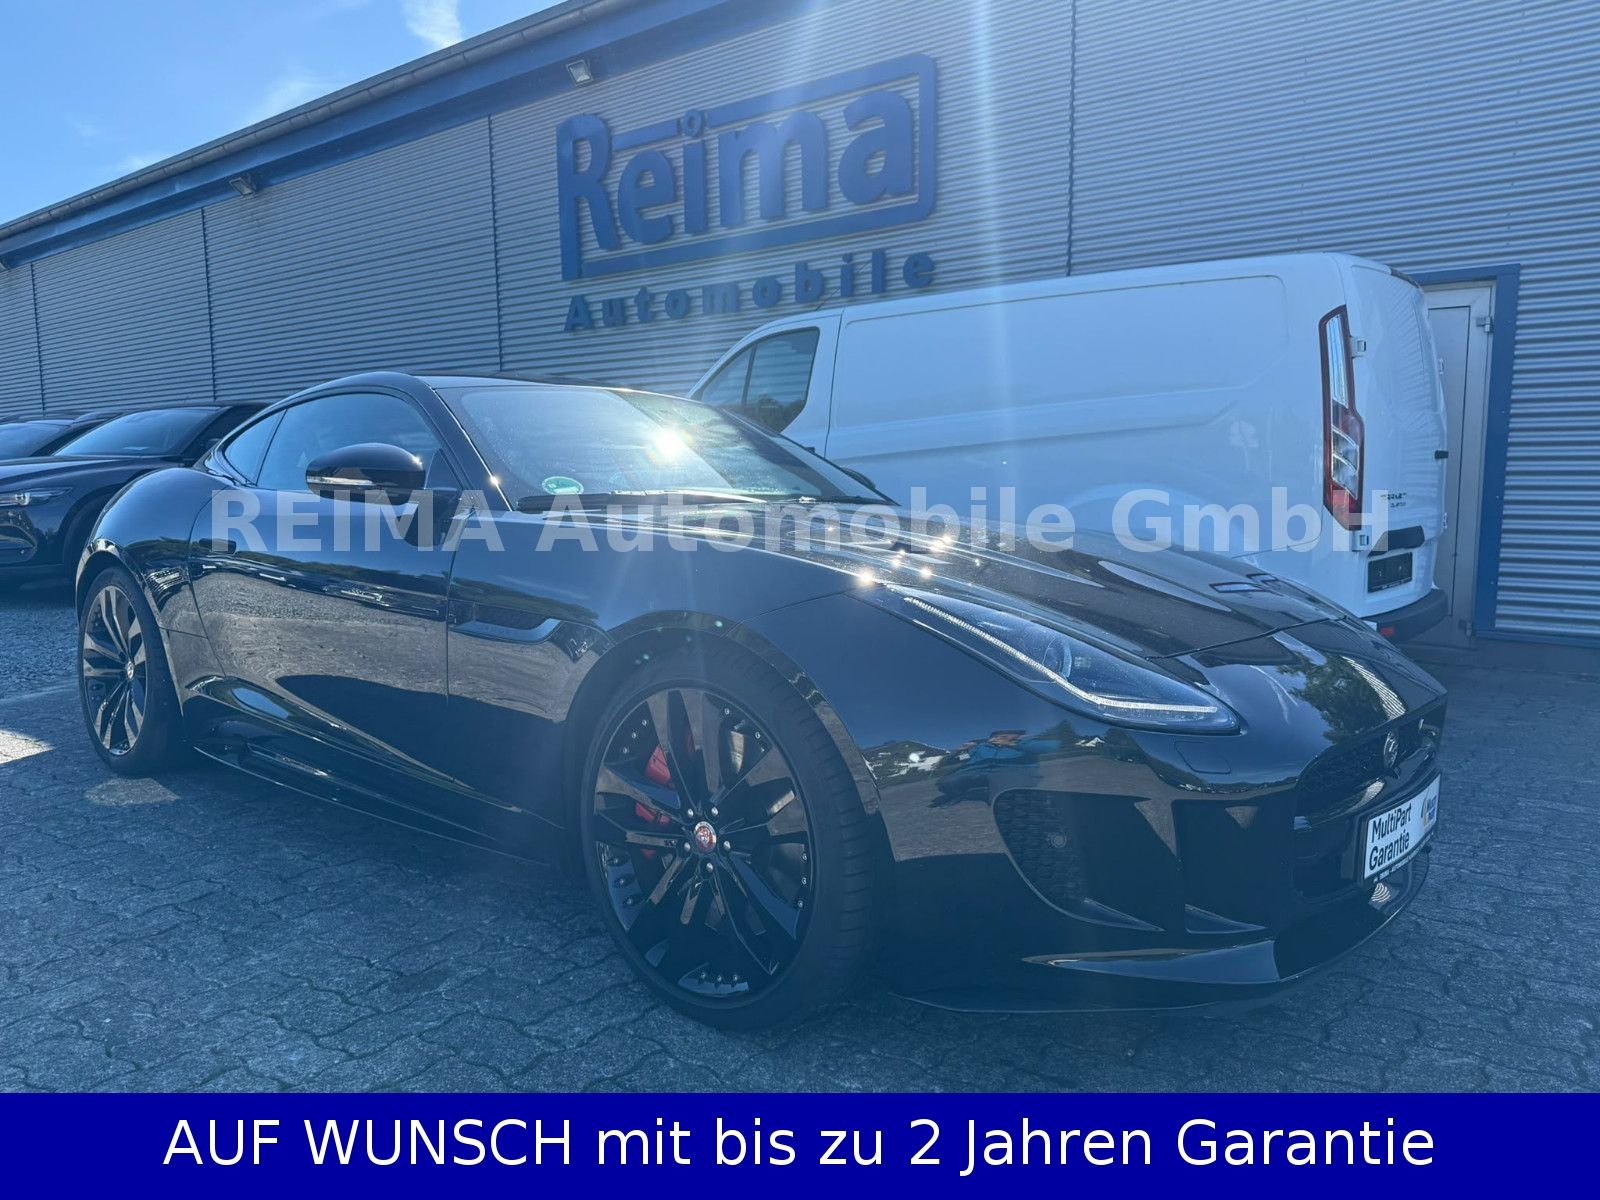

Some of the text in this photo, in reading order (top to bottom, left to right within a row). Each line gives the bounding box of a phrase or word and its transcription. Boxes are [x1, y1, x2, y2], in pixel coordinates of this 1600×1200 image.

[556, 91, 916, 280] Reima
[564, 249, 936, 332] Automobile
[1369, 829, 1410, 871] Garantie
[1371, 803, 1412, 843] MultiPart
